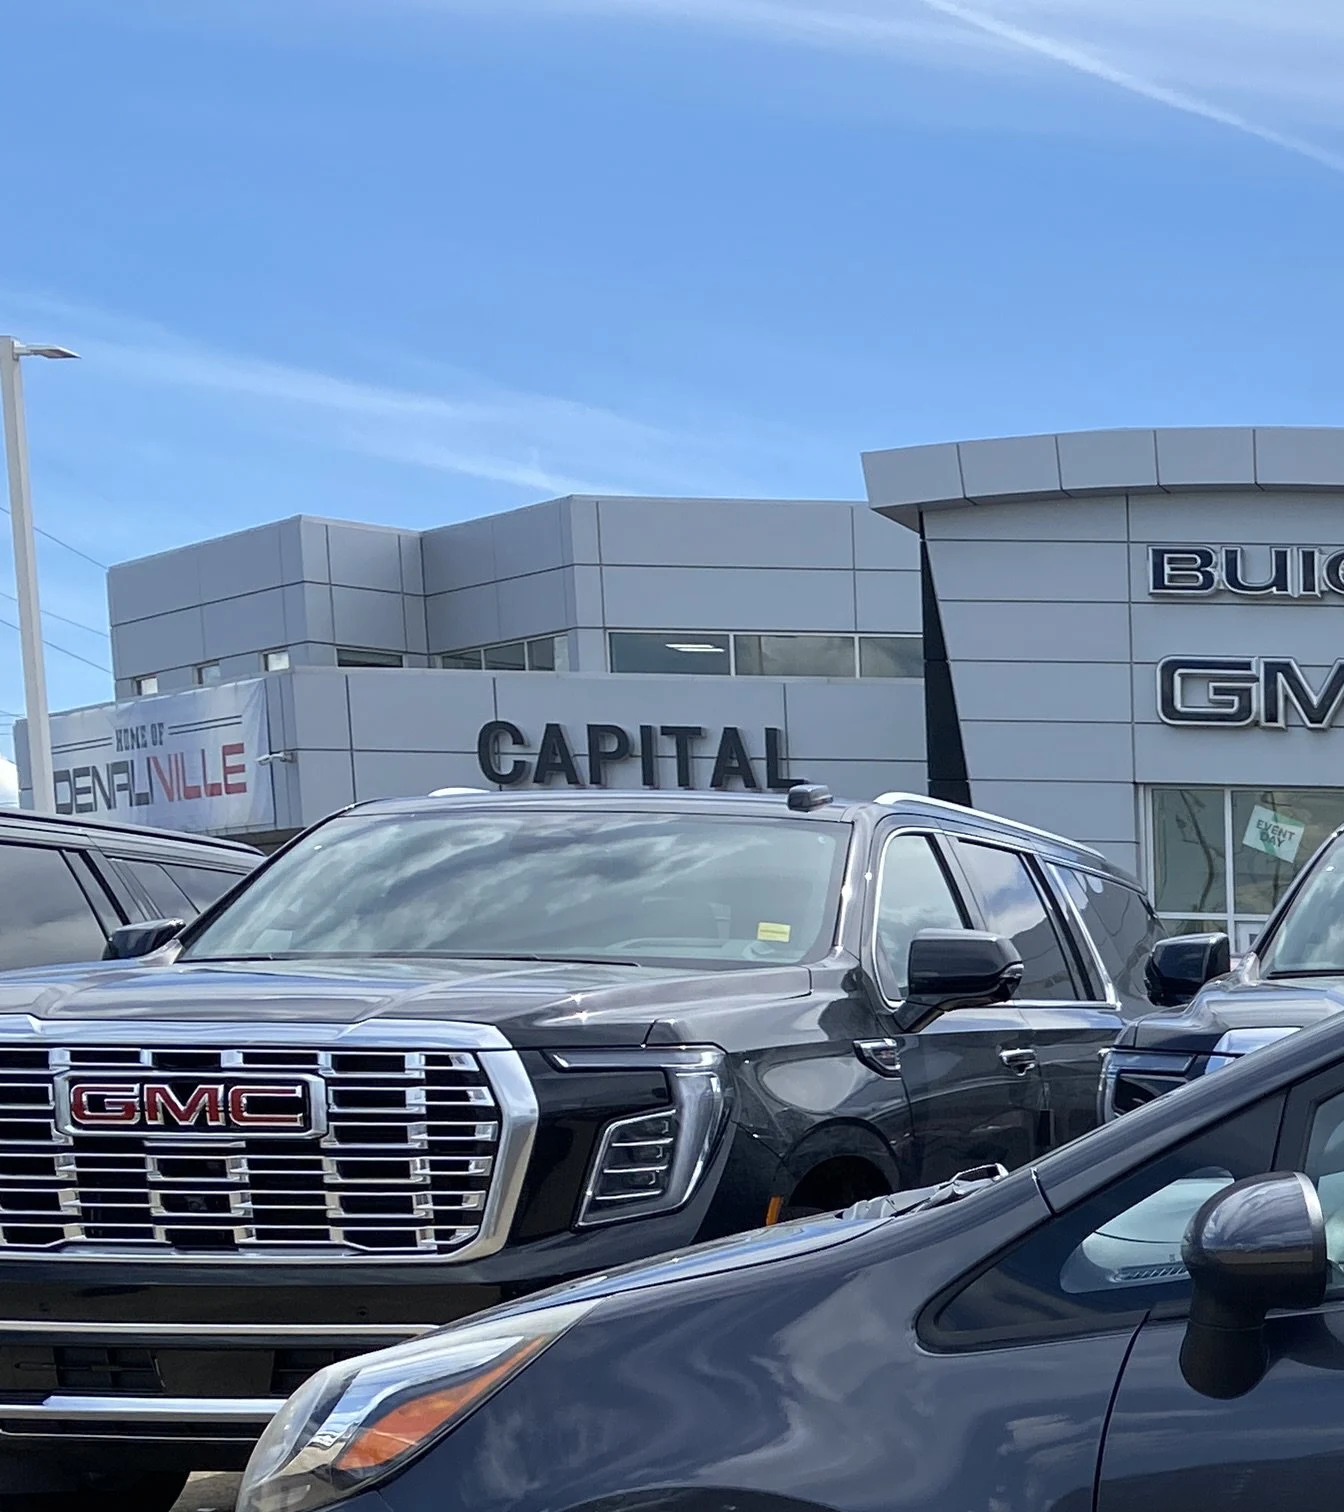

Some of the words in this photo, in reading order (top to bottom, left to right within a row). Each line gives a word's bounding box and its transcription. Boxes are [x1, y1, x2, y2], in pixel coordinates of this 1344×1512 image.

[115, 726, 148, 752] HOME
[150, 722, 165, 747] OF
[477, 720, 809, 789] CAPITAL
[53, 742, 247, 816] DENALIVILLE
[1256, 819, 1295, 841] EVENT
[1260, 831, 1285, 848] DAY
[70, 1083, 304, 1127] GMC
